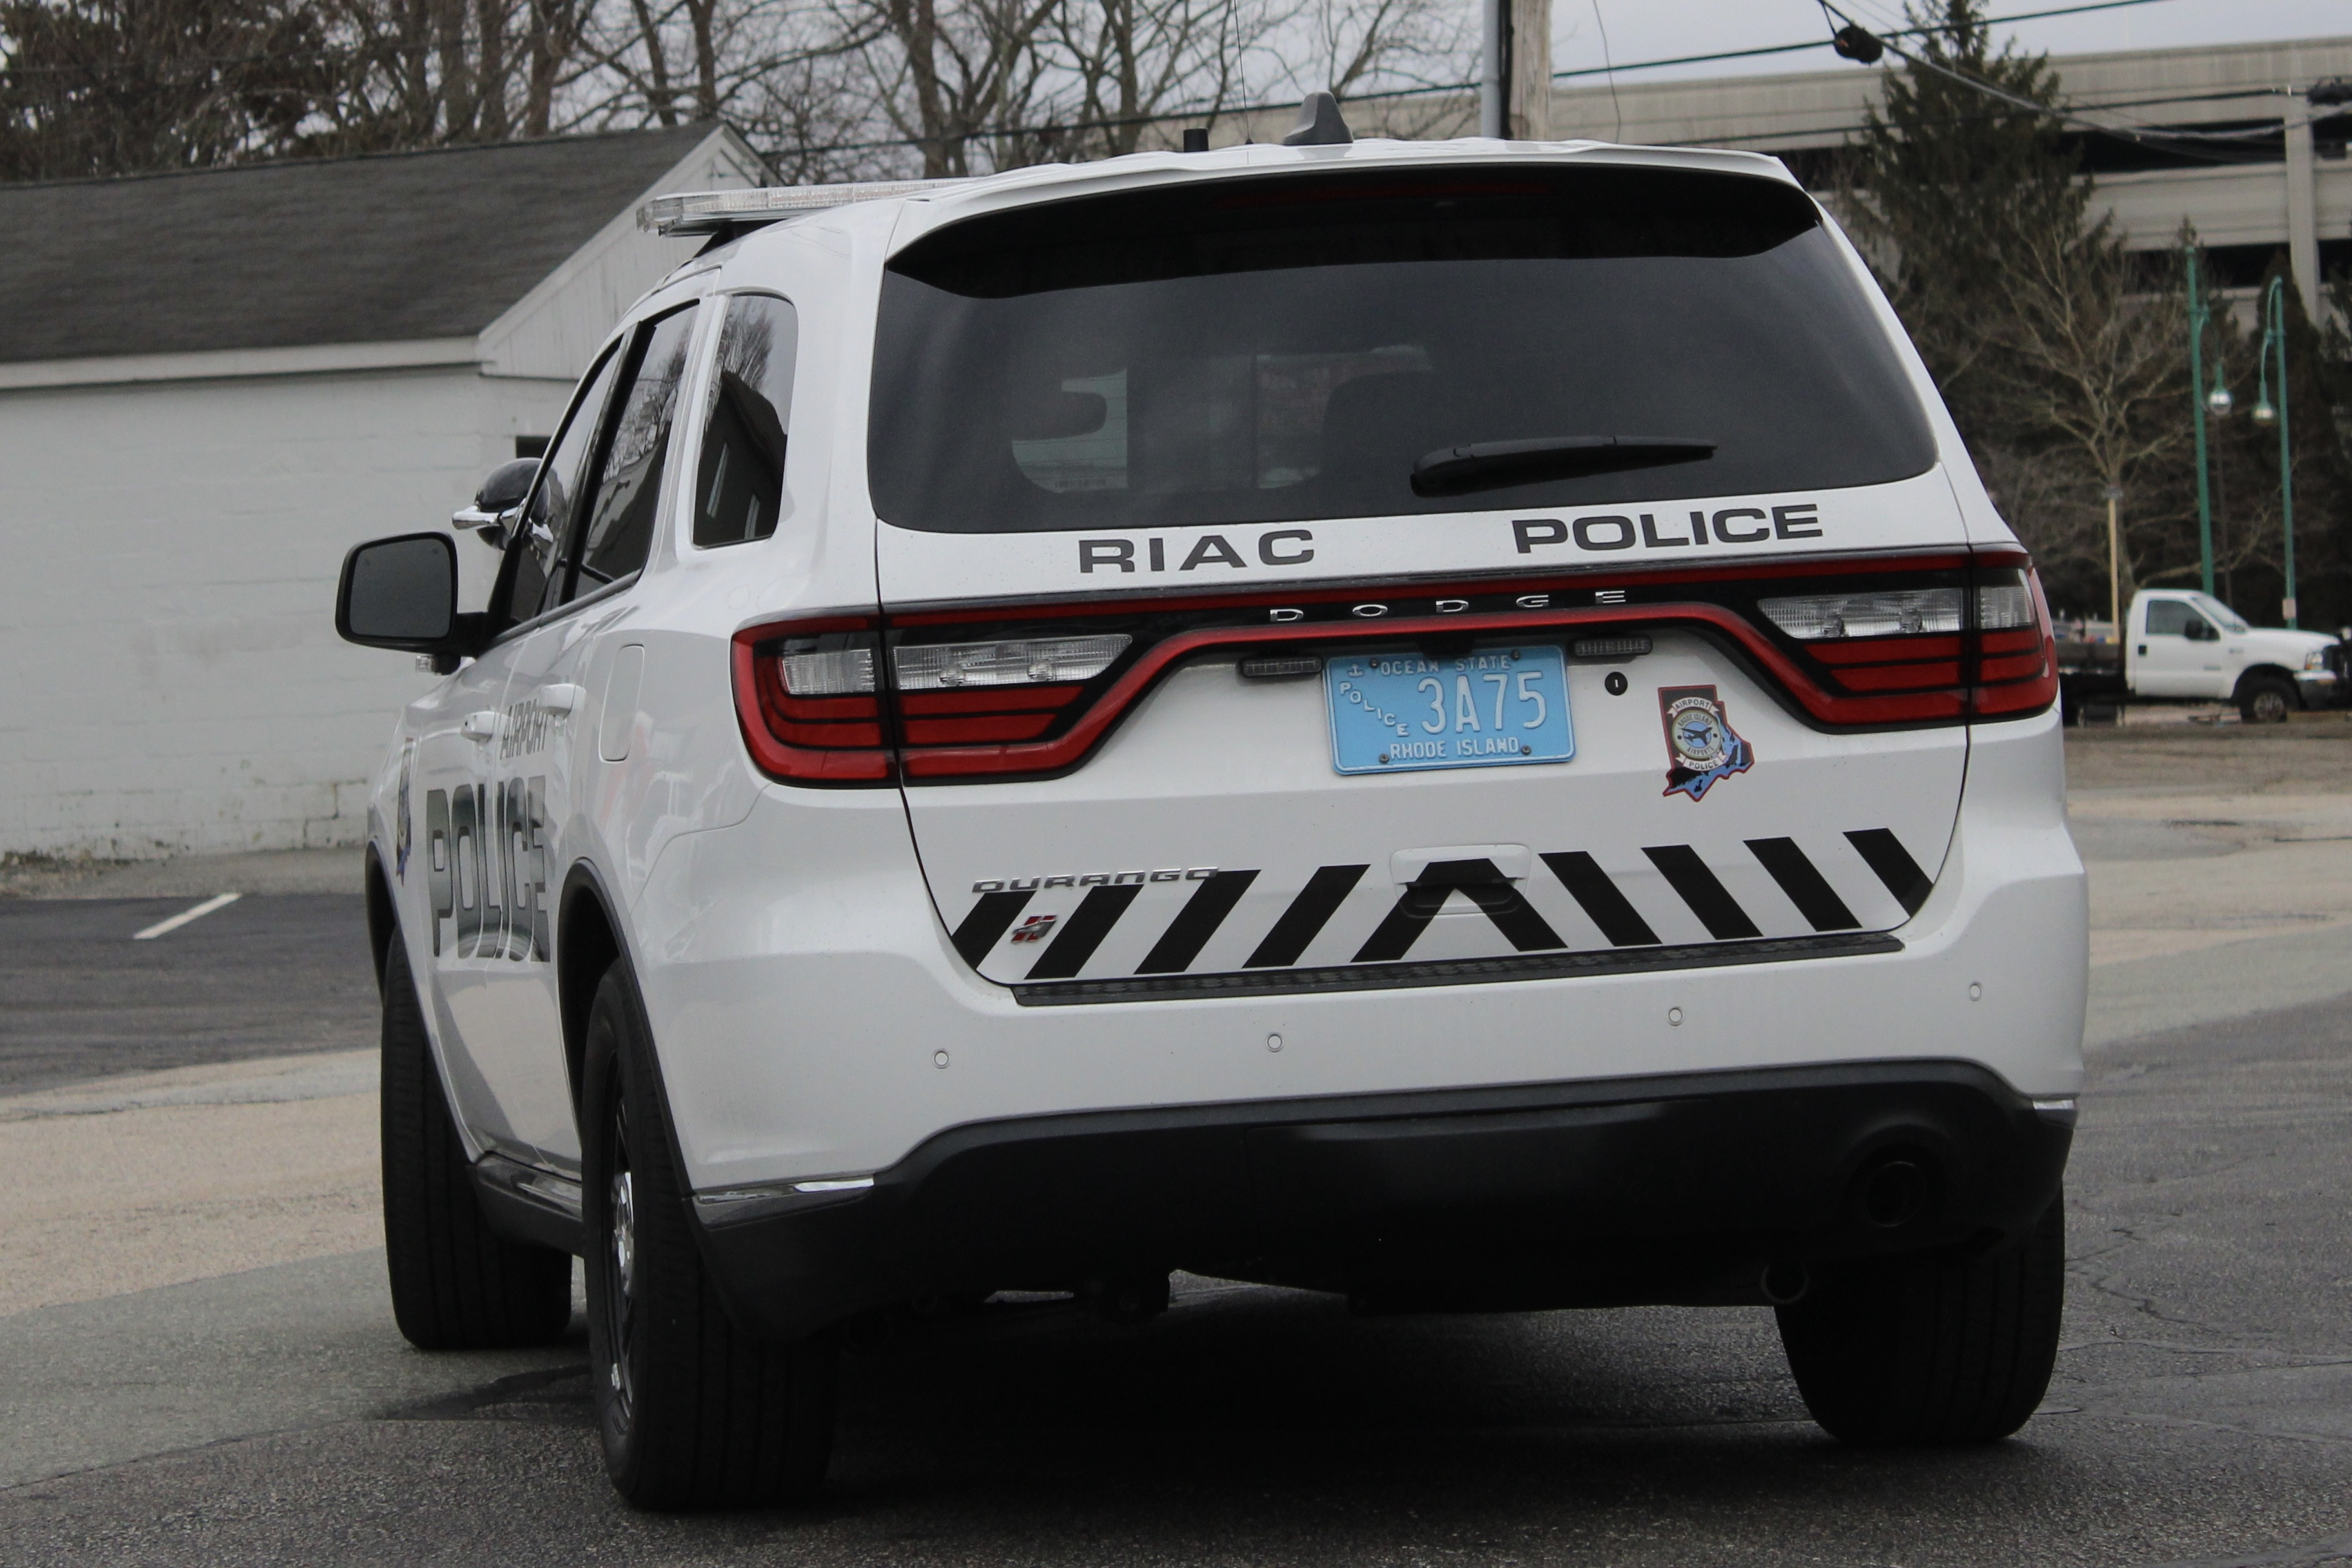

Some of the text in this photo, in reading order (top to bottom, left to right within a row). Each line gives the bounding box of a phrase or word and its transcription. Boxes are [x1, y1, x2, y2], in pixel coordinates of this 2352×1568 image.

[1079, 504, 1823, 574] RIAC POLICE
[1270, 590, 1626, 622] DODGE
[1381, 655, 1510, 676] OCEAN STATE
[1340, 681, 1410, 736] POLICE
[1418, 671, 1547, 734] 3A75
[1676, 699, 1709, 709] AIRPORT
[1390, 736, 1519, 759] RHODE ISLAND
[1687, 746, 1714, 756] AIRPORTS
[1689, 761, 1718, 770] POLICE
[426, 774, 551, 963] POLICE
[972, 867, 1219, 893] DURANGO
